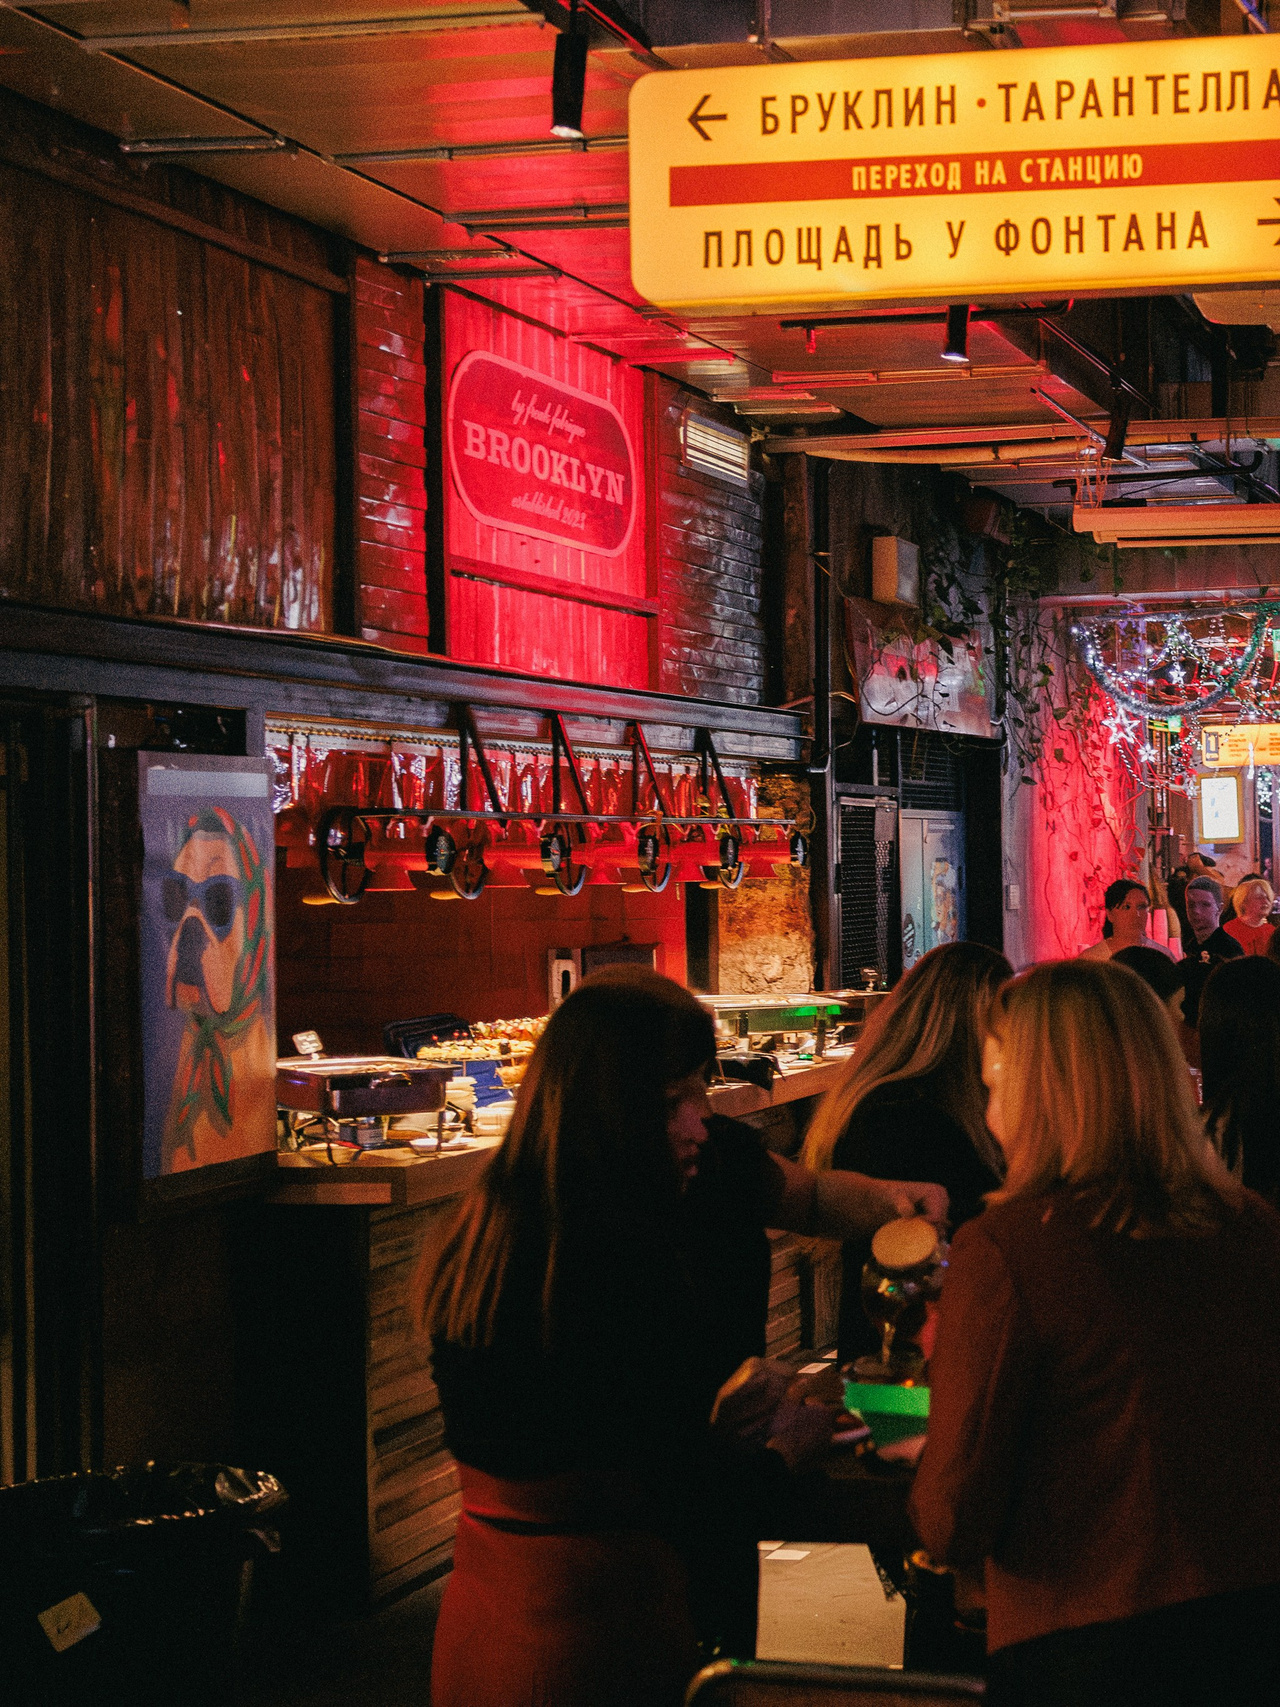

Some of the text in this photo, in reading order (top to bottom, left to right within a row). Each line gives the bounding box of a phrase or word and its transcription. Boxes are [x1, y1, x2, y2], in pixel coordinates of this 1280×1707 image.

[759, 83, 958, 136] БРУКЛИН
[851, 152, 1144, 193] ПЕРЕХОД НА СТАНЦИЮ
[703, 210, 1210, 270] ПЛОЩАДЬ У ФОНТАНА
[462, 418, 625, 506] BROOKLYN
